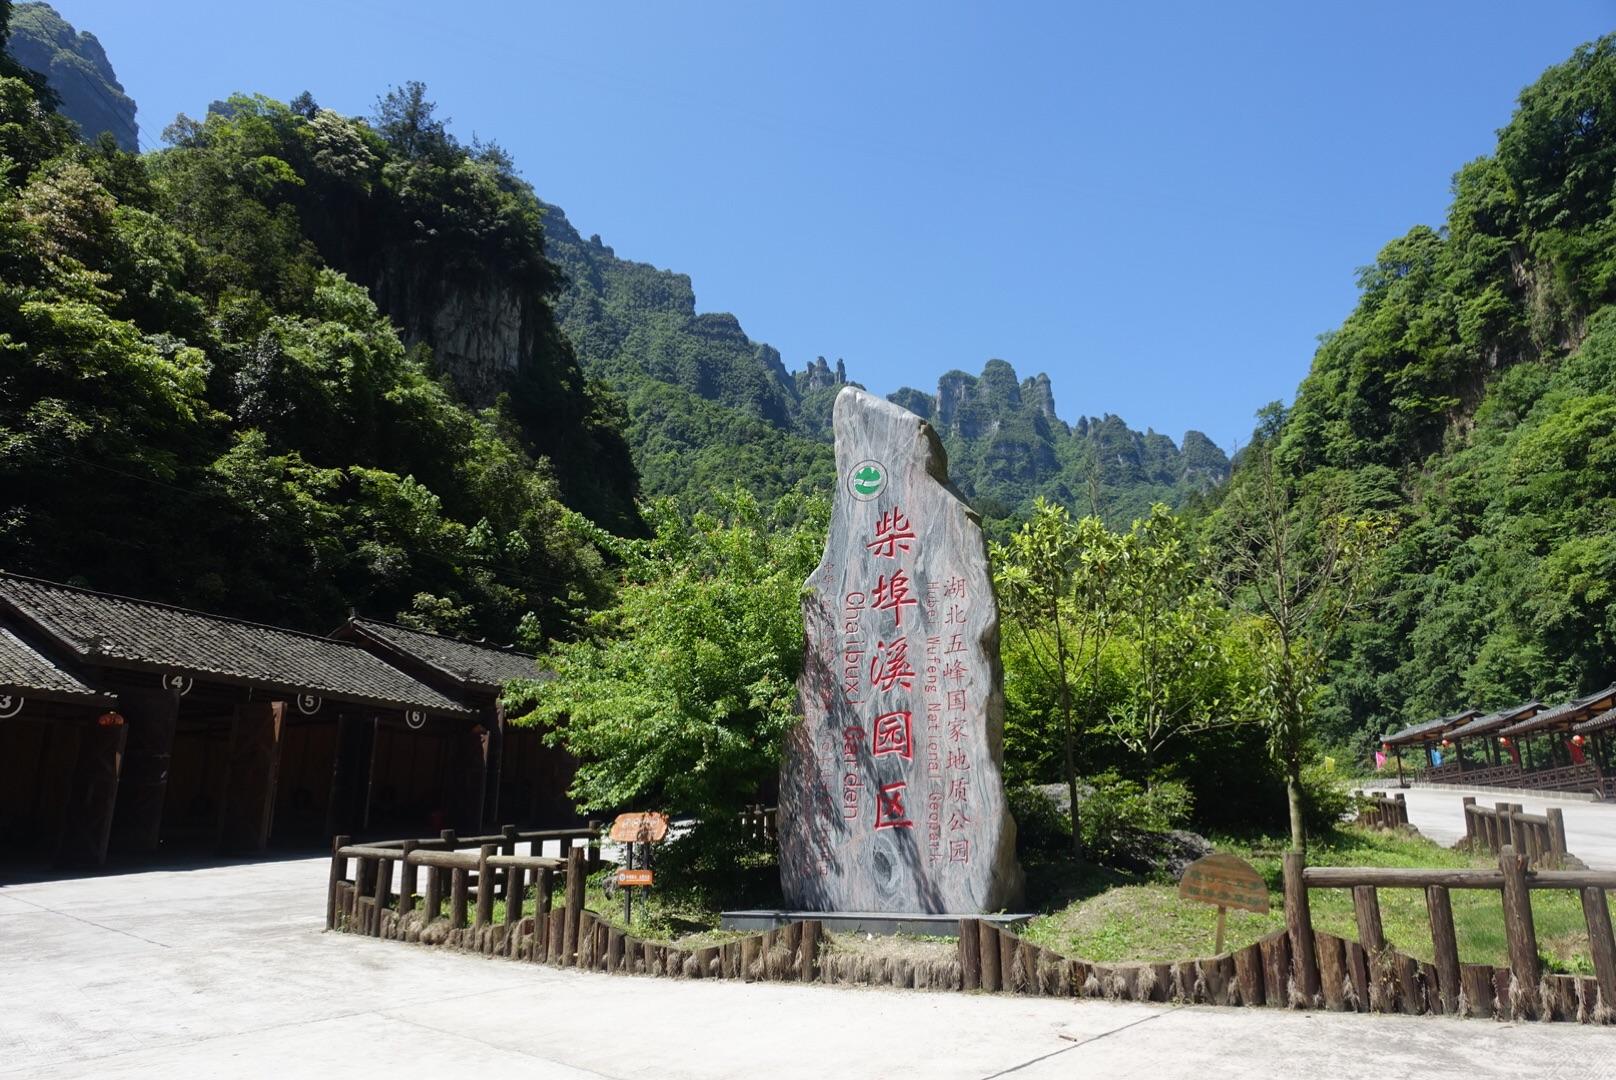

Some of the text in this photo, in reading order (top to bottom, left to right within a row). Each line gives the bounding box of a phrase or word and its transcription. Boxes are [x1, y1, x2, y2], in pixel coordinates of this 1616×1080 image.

[171, 675, 183, 688] 4
[842, 591, 867, 821] Chaibuxi Garden
[866, 505, 918, 832] 柴埠溪园区
[924, 581, 944, 863] Hubei Wufeng National Geopark
[942, 575, 971, 865] 湖北五峰国家地质公园
